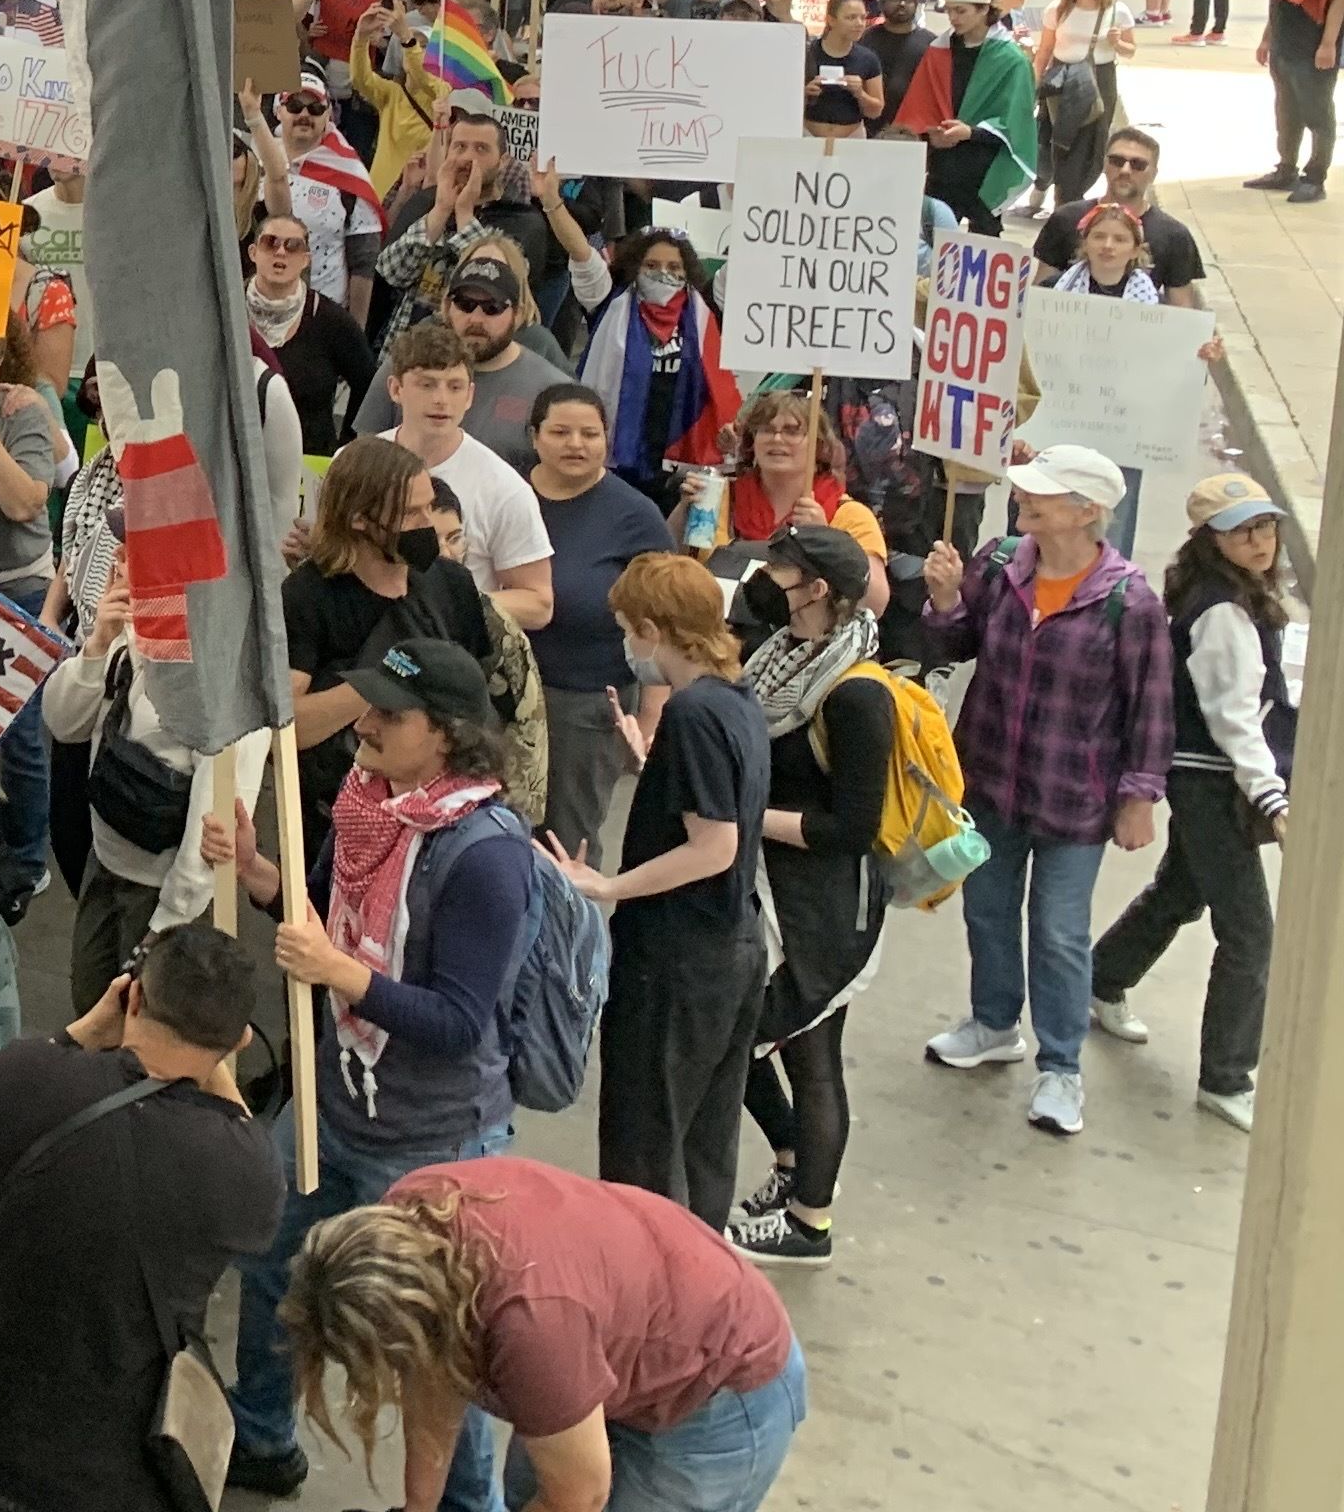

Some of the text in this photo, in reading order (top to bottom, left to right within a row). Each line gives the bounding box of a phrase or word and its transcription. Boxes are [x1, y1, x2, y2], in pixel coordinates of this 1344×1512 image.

[585, 27, 709, 90] FUCK
[15, 100, 88, 156] 1776
[794, 170, 852, 210] NO
[742, 205, 899, 257] SOLDIERS
[779, 254, 890, 298] IN OUR
[936, 241, 1032, 319] OMG!
[743, 301, 897, 356] STREETS
[927, 306, 1009, 385] GOP
[918, 378, 1016, 468] WTF?
